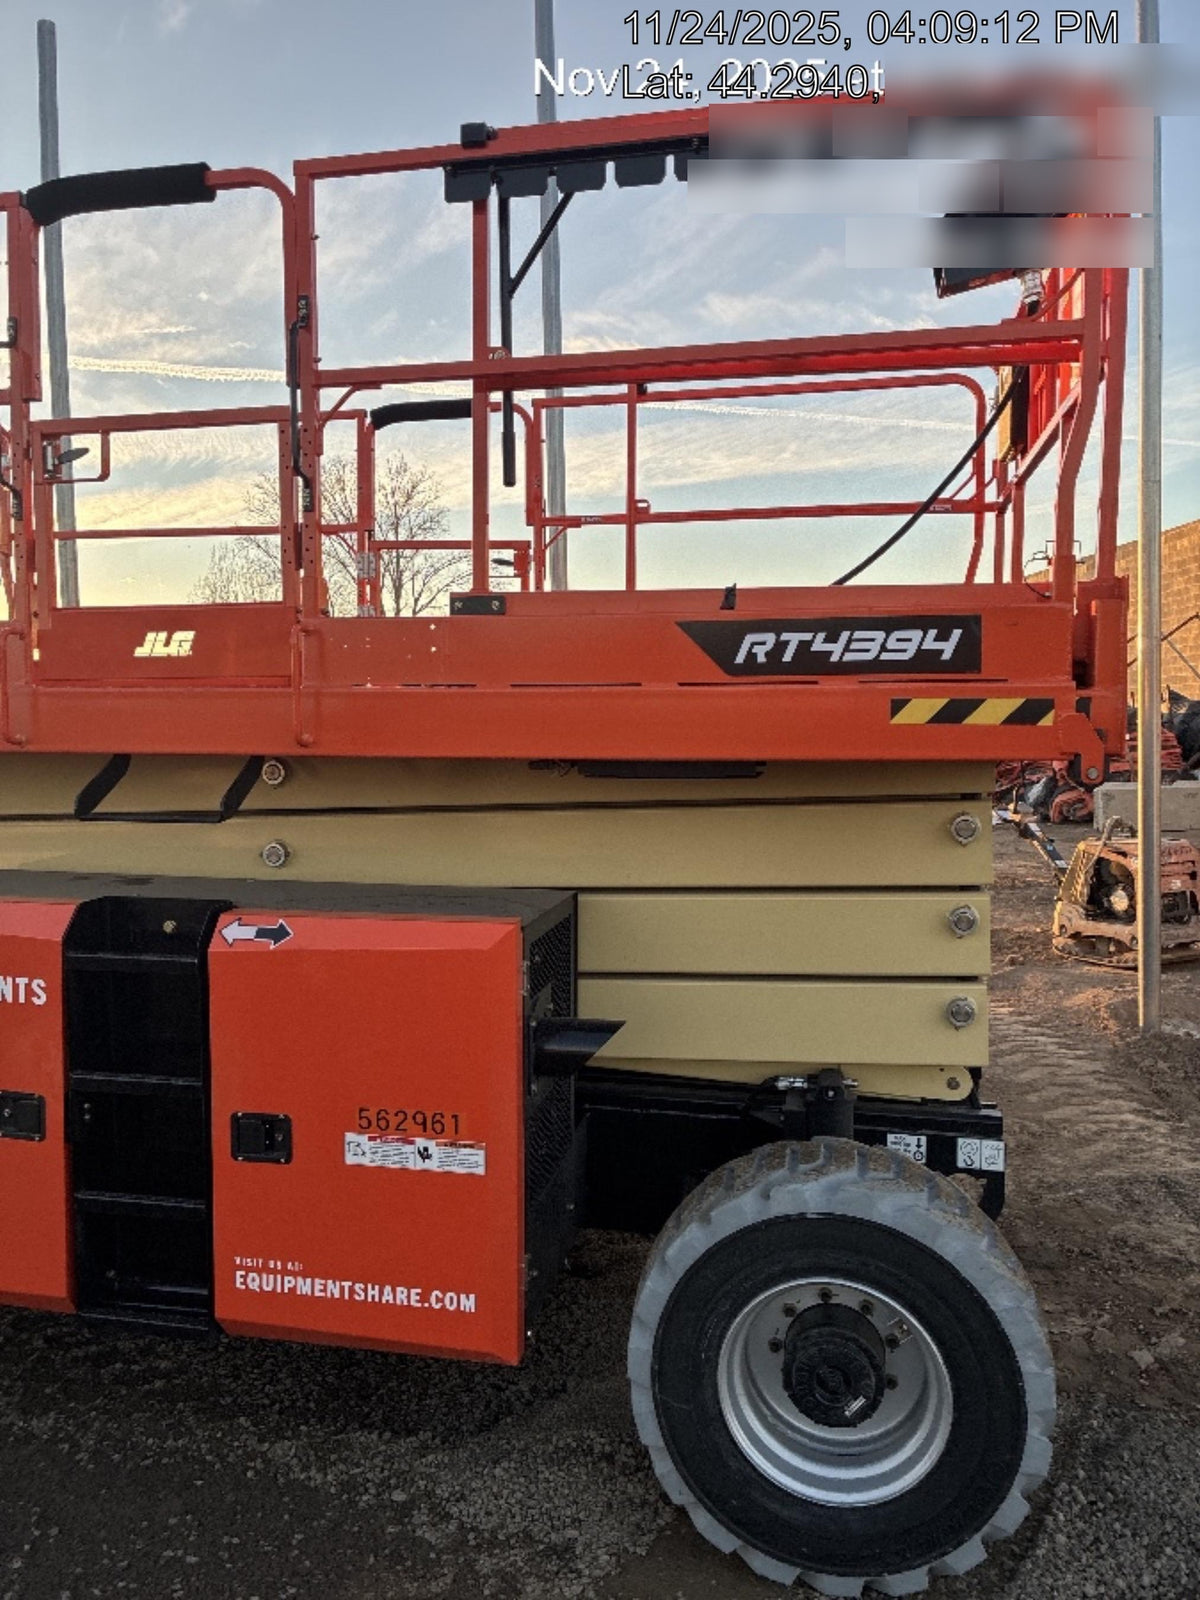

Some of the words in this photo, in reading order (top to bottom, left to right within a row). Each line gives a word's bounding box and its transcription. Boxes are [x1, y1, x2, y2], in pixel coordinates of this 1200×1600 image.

[133, 630, 196, 657] JLG
[734, 628, 963, 664] RT4394
[358, 1107, 460, 1135] 562961
[235, 1270, 477, 1313] EQUIPMENTSHARE.COM
